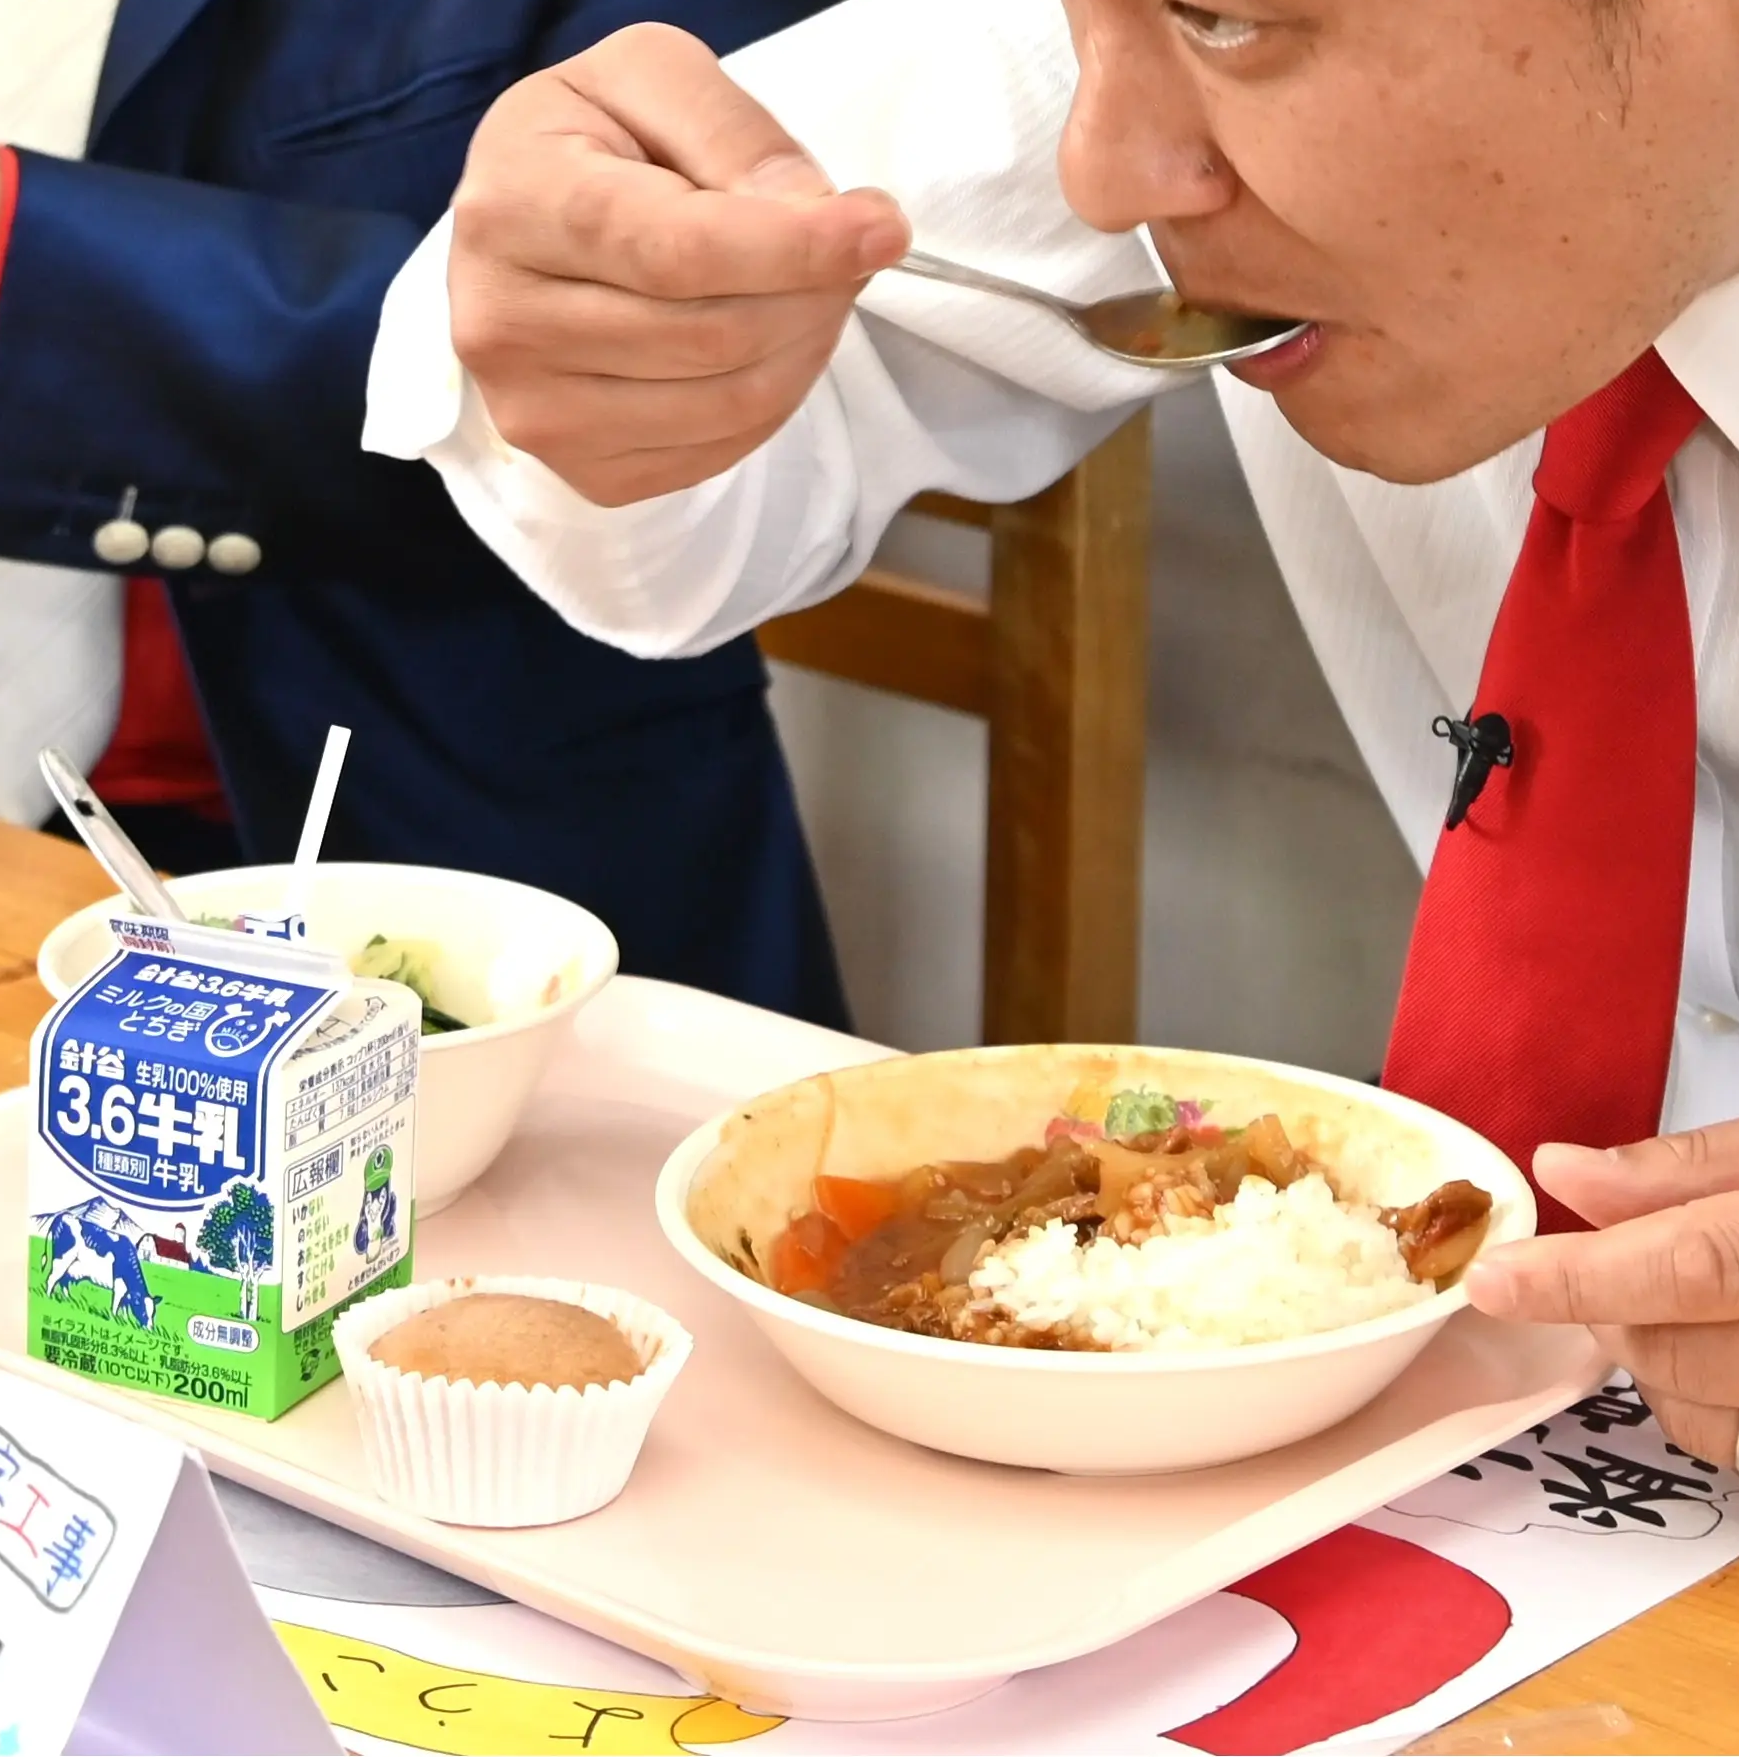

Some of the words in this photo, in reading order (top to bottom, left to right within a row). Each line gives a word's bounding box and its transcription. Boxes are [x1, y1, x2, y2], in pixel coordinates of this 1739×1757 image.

[95, 984, 218, 1020] ミルクの国
[133, 963, 295, 1008] 針谷3.6牛乳
[118, 1009, 201, 1042] とちぎ
[60, 1038, 125, 1081] 針谷
[135, 1060, 249, 1106] 生乳100%使用
[57, 1074, 246, 1171] 3.6牛乳
[97, 1149, 146, 1179] 種類別
[153, 1157, 205, 1195] 牛乳
[291, 1148, 341, 1197] 広報欄
[192, 1319, 254, 1350] 成分無調整
[172, 1373, 249, 1409] 200ml
